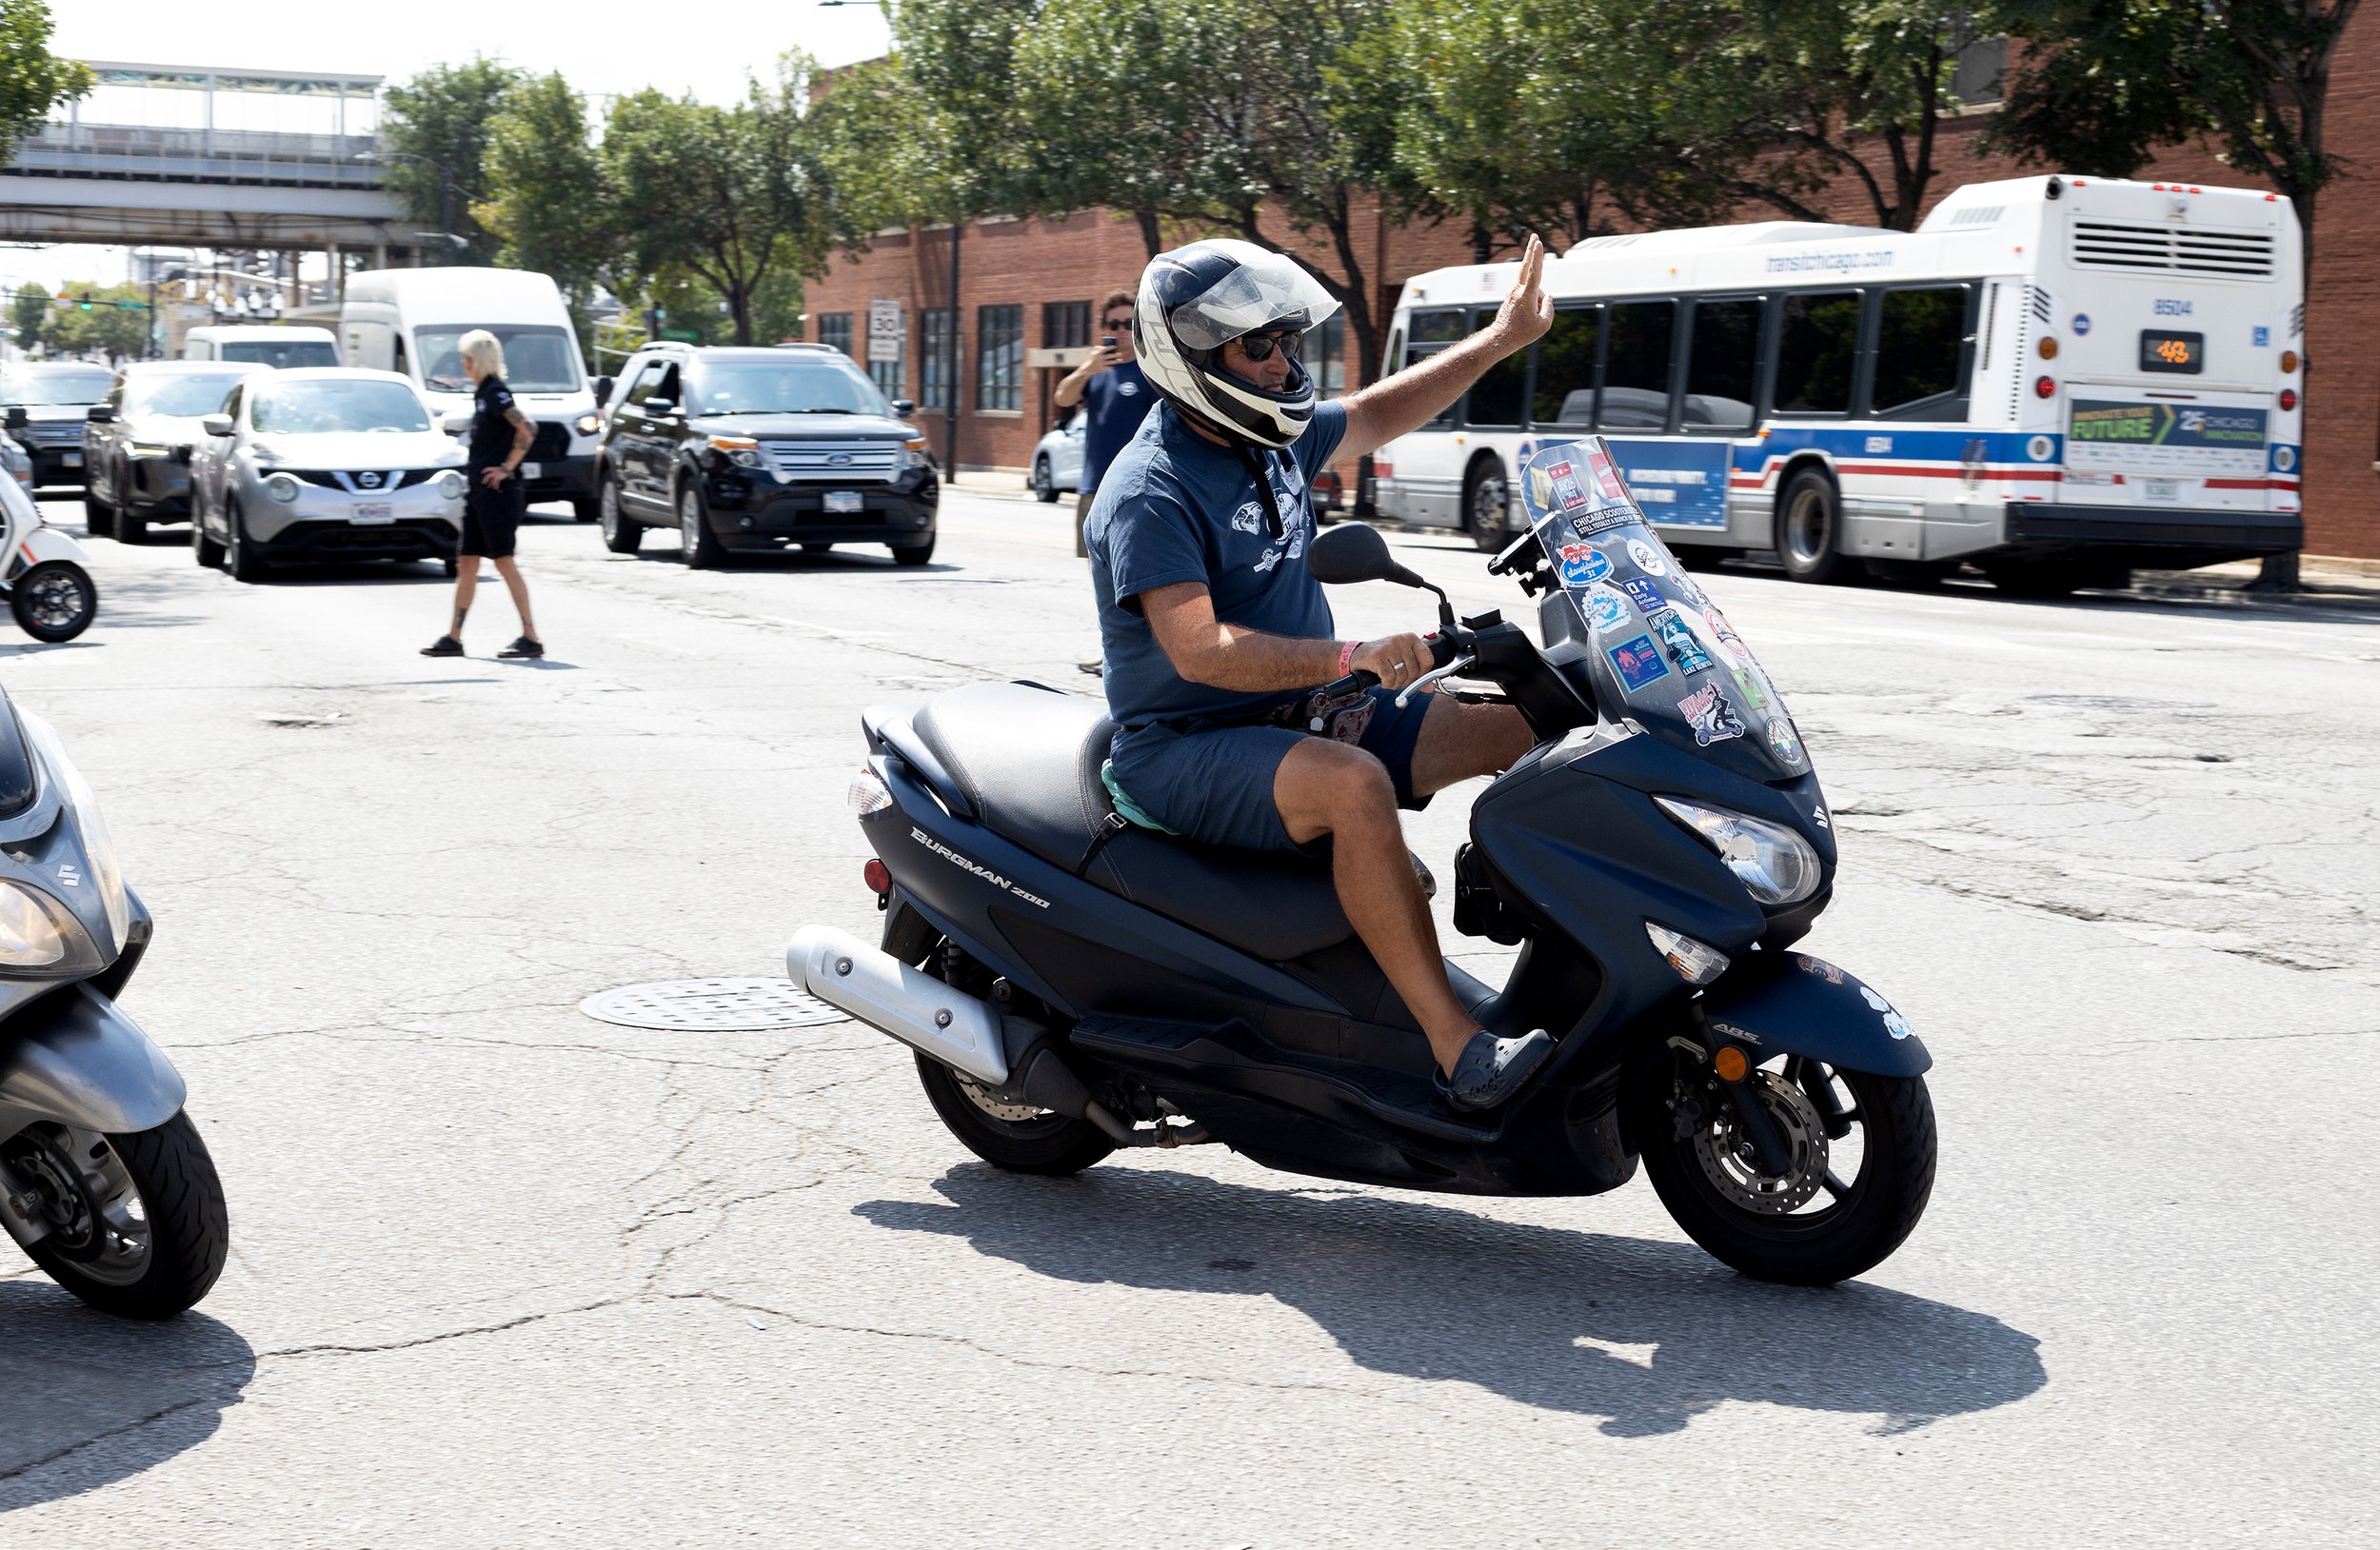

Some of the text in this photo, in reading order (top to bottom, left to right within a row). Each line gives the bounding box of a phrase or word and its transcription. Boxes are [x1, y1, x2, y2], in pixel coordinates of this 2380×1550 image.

[1766, 249, 1894, 274] transitchicago.com
[2153, 299, 2192, 316] 8504
[875, 317, 896, 332] 30
[2072, 417, 2153, 440] FUTURE
[1573, 510, 1605, 528] CHICAGO
[1577, 524, 1595, 535] STILL
[1634, 592, 1648, 601] Early
[1637, 596, 1657, 606] Arrivals
[1682, 660, 1714, 676] LAKE GENEVA
[910, 826, 1051, 909] BURGMAN 200
[1714, 1023, 1760, 1042] ABS
